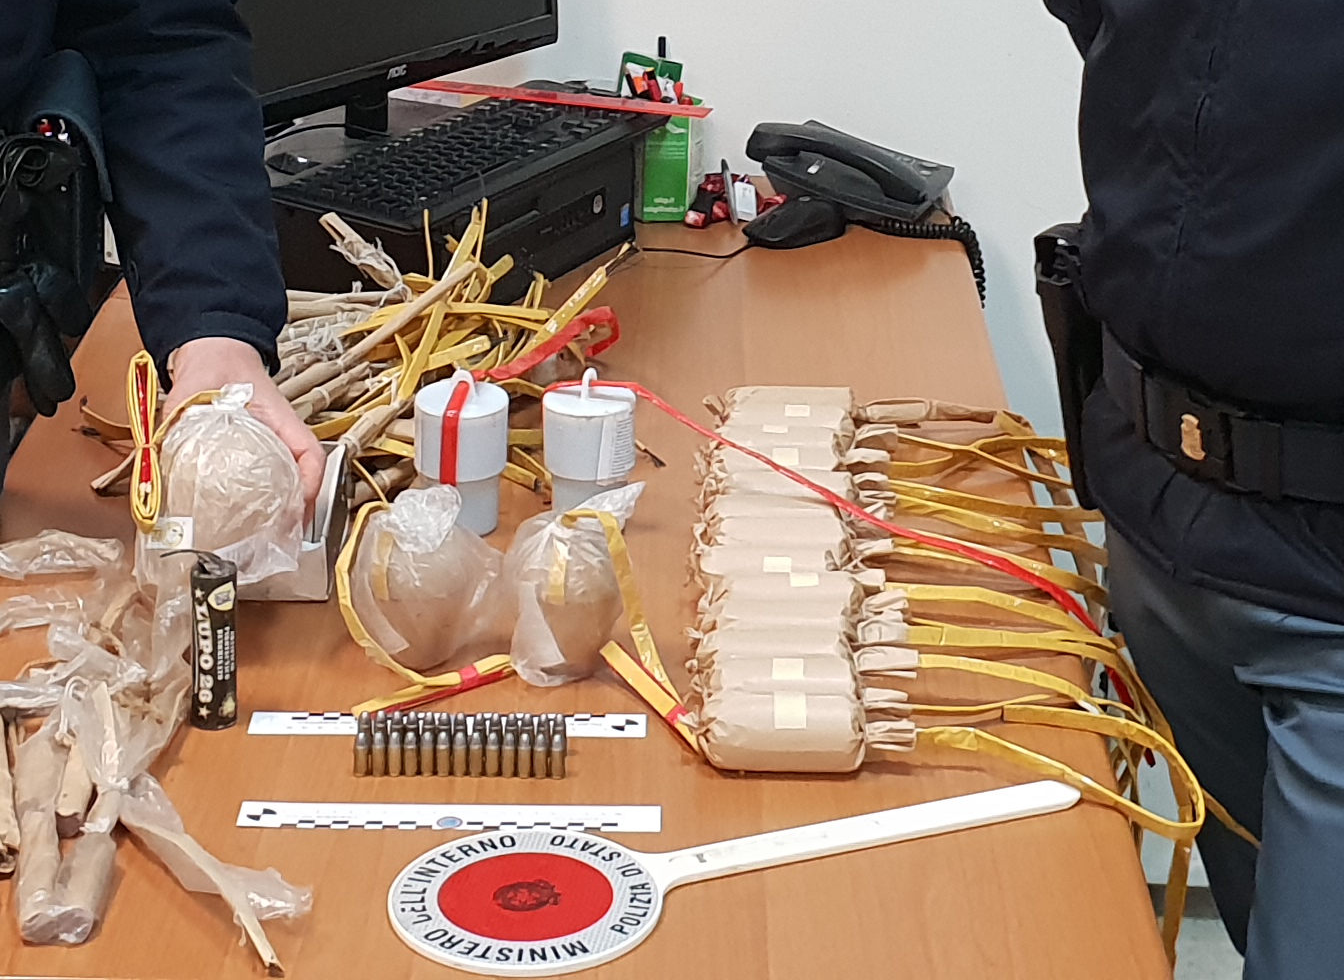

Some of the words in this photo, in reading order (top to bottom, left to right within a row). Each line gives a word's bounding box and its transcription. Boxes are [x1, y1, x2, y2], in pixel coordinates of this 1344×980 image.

[550, 835, 622, 863] STATO
[615, 862, 643, 878] DI
[610, 882, 652, 935] POLIZIA
[423, 928, 591, 963] MINISTERO
